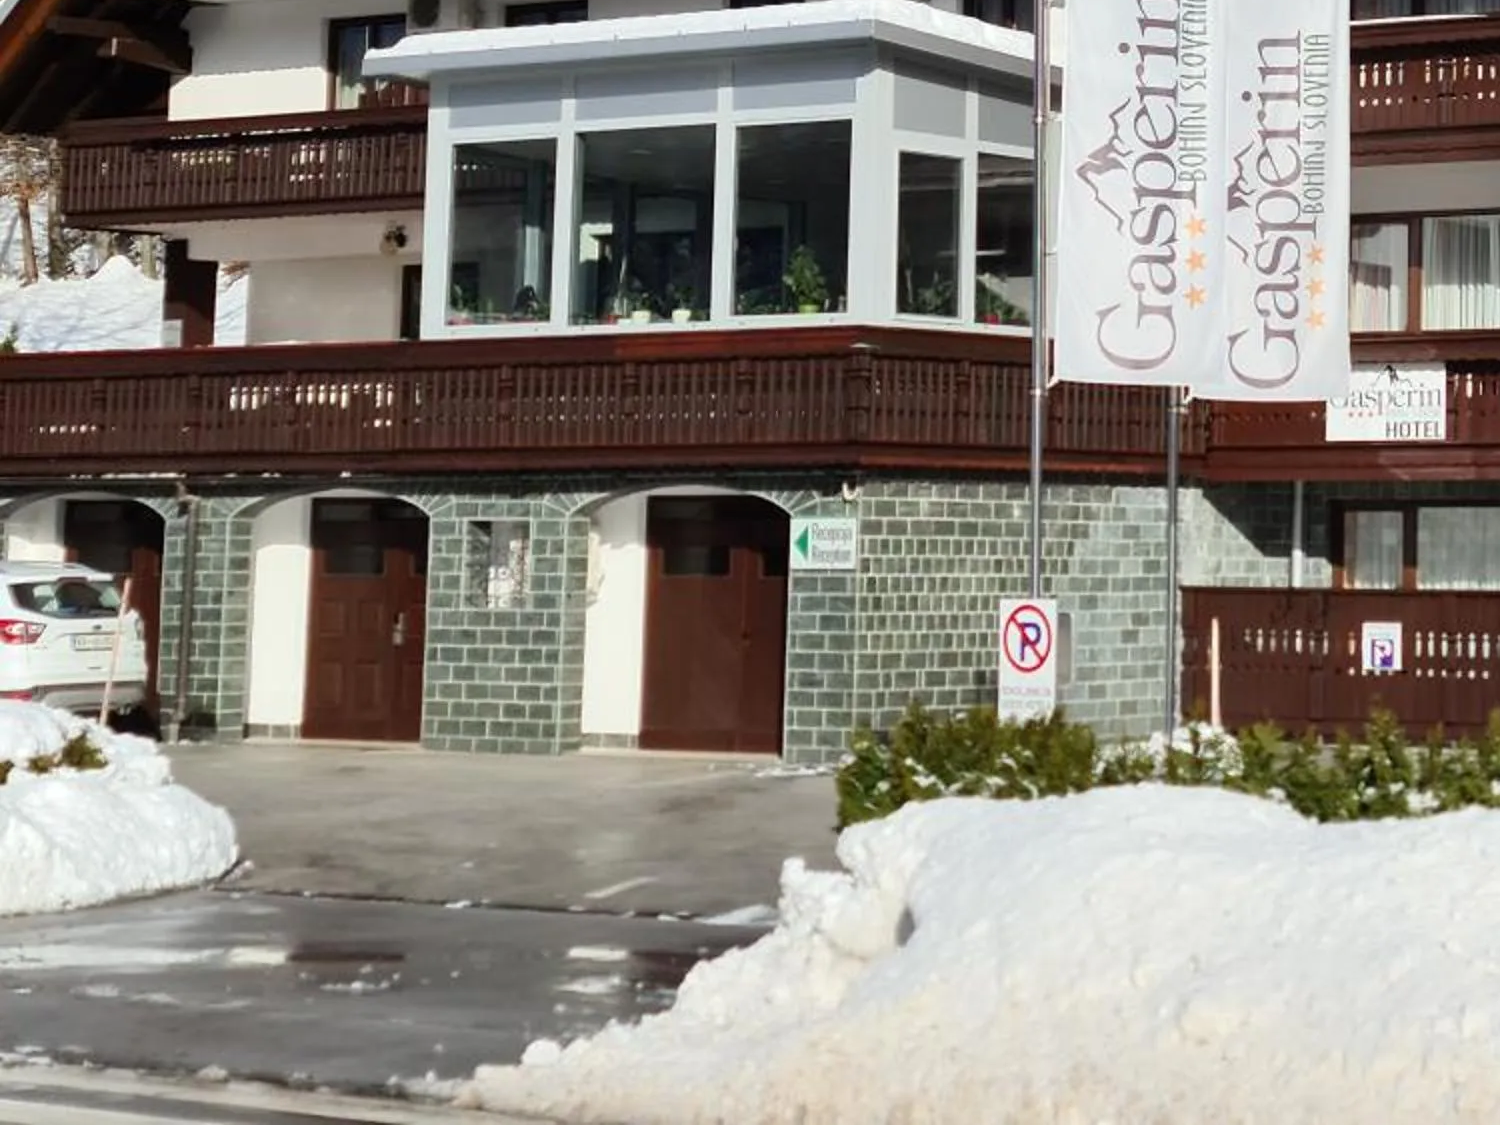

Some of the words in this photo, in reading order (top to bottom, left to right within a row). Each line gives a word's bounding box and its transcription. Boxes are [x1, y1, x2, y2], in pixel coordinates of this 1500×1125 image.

[1303, 33, 1331, 130] SLOVENIA
[1177, 102, 1208, 182] BOHINJ
[1301, 140, 1326, 215] BOHINJ
[1385, 420, 1442, 439] HOTEL
